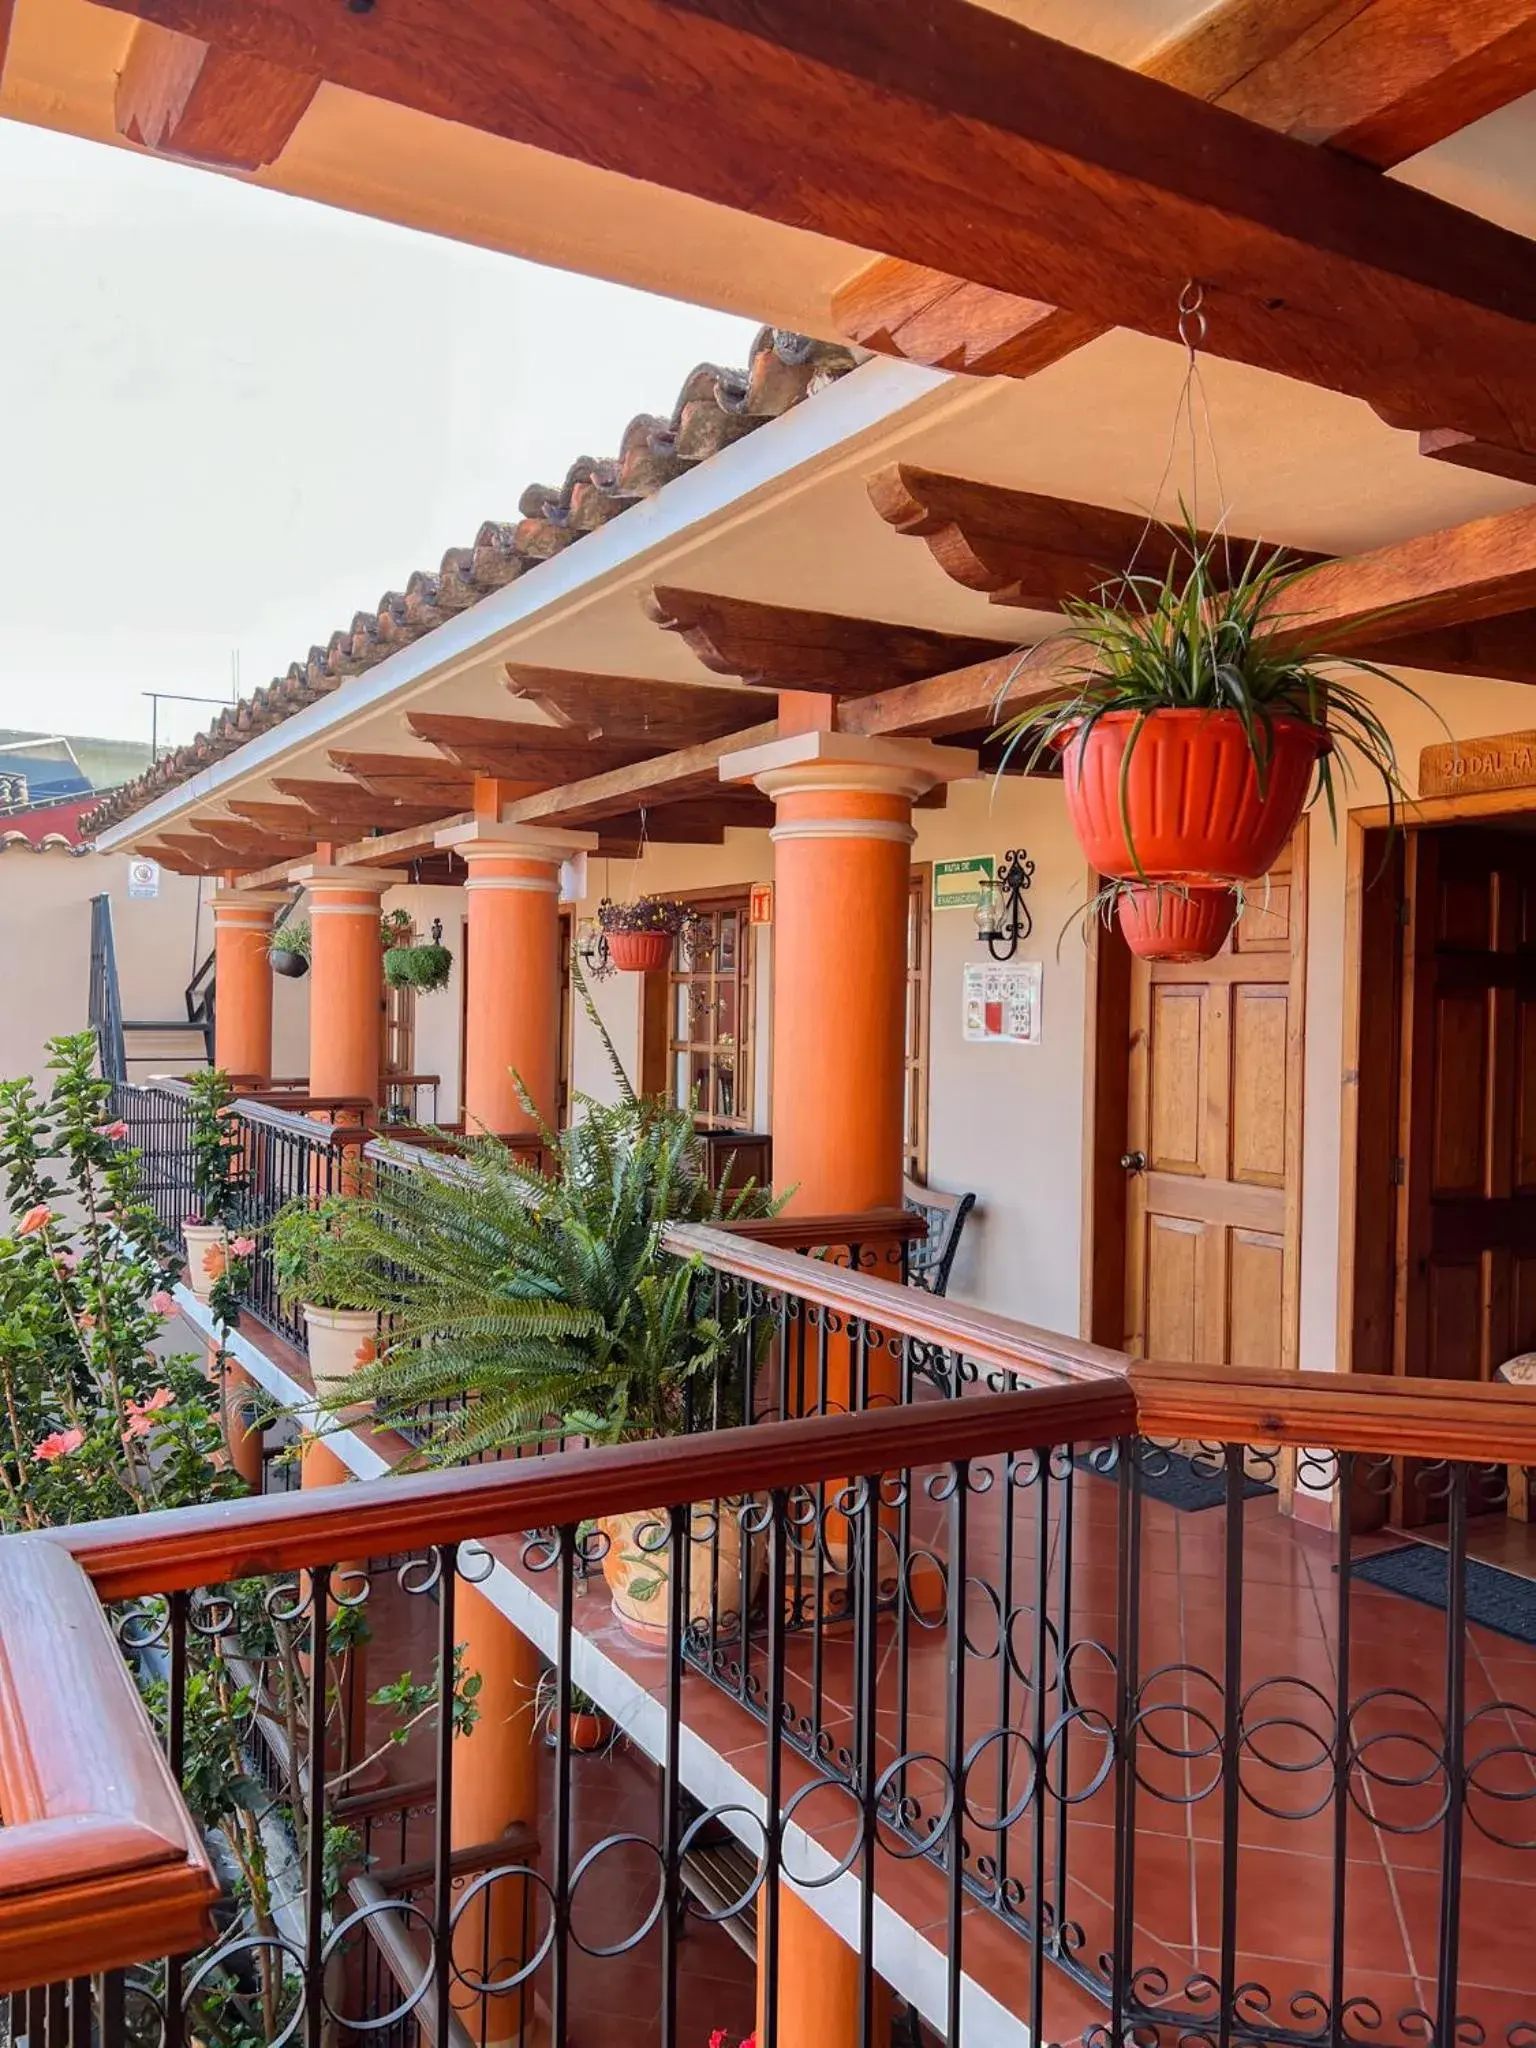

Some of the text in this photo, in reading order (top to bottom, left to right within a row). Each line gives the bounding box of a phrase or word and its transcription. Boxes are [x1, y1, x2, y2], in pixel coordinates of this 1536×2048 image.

[1445, 758, 1468, 779] 20
[944, 861, 971, 873] RUTA DE
